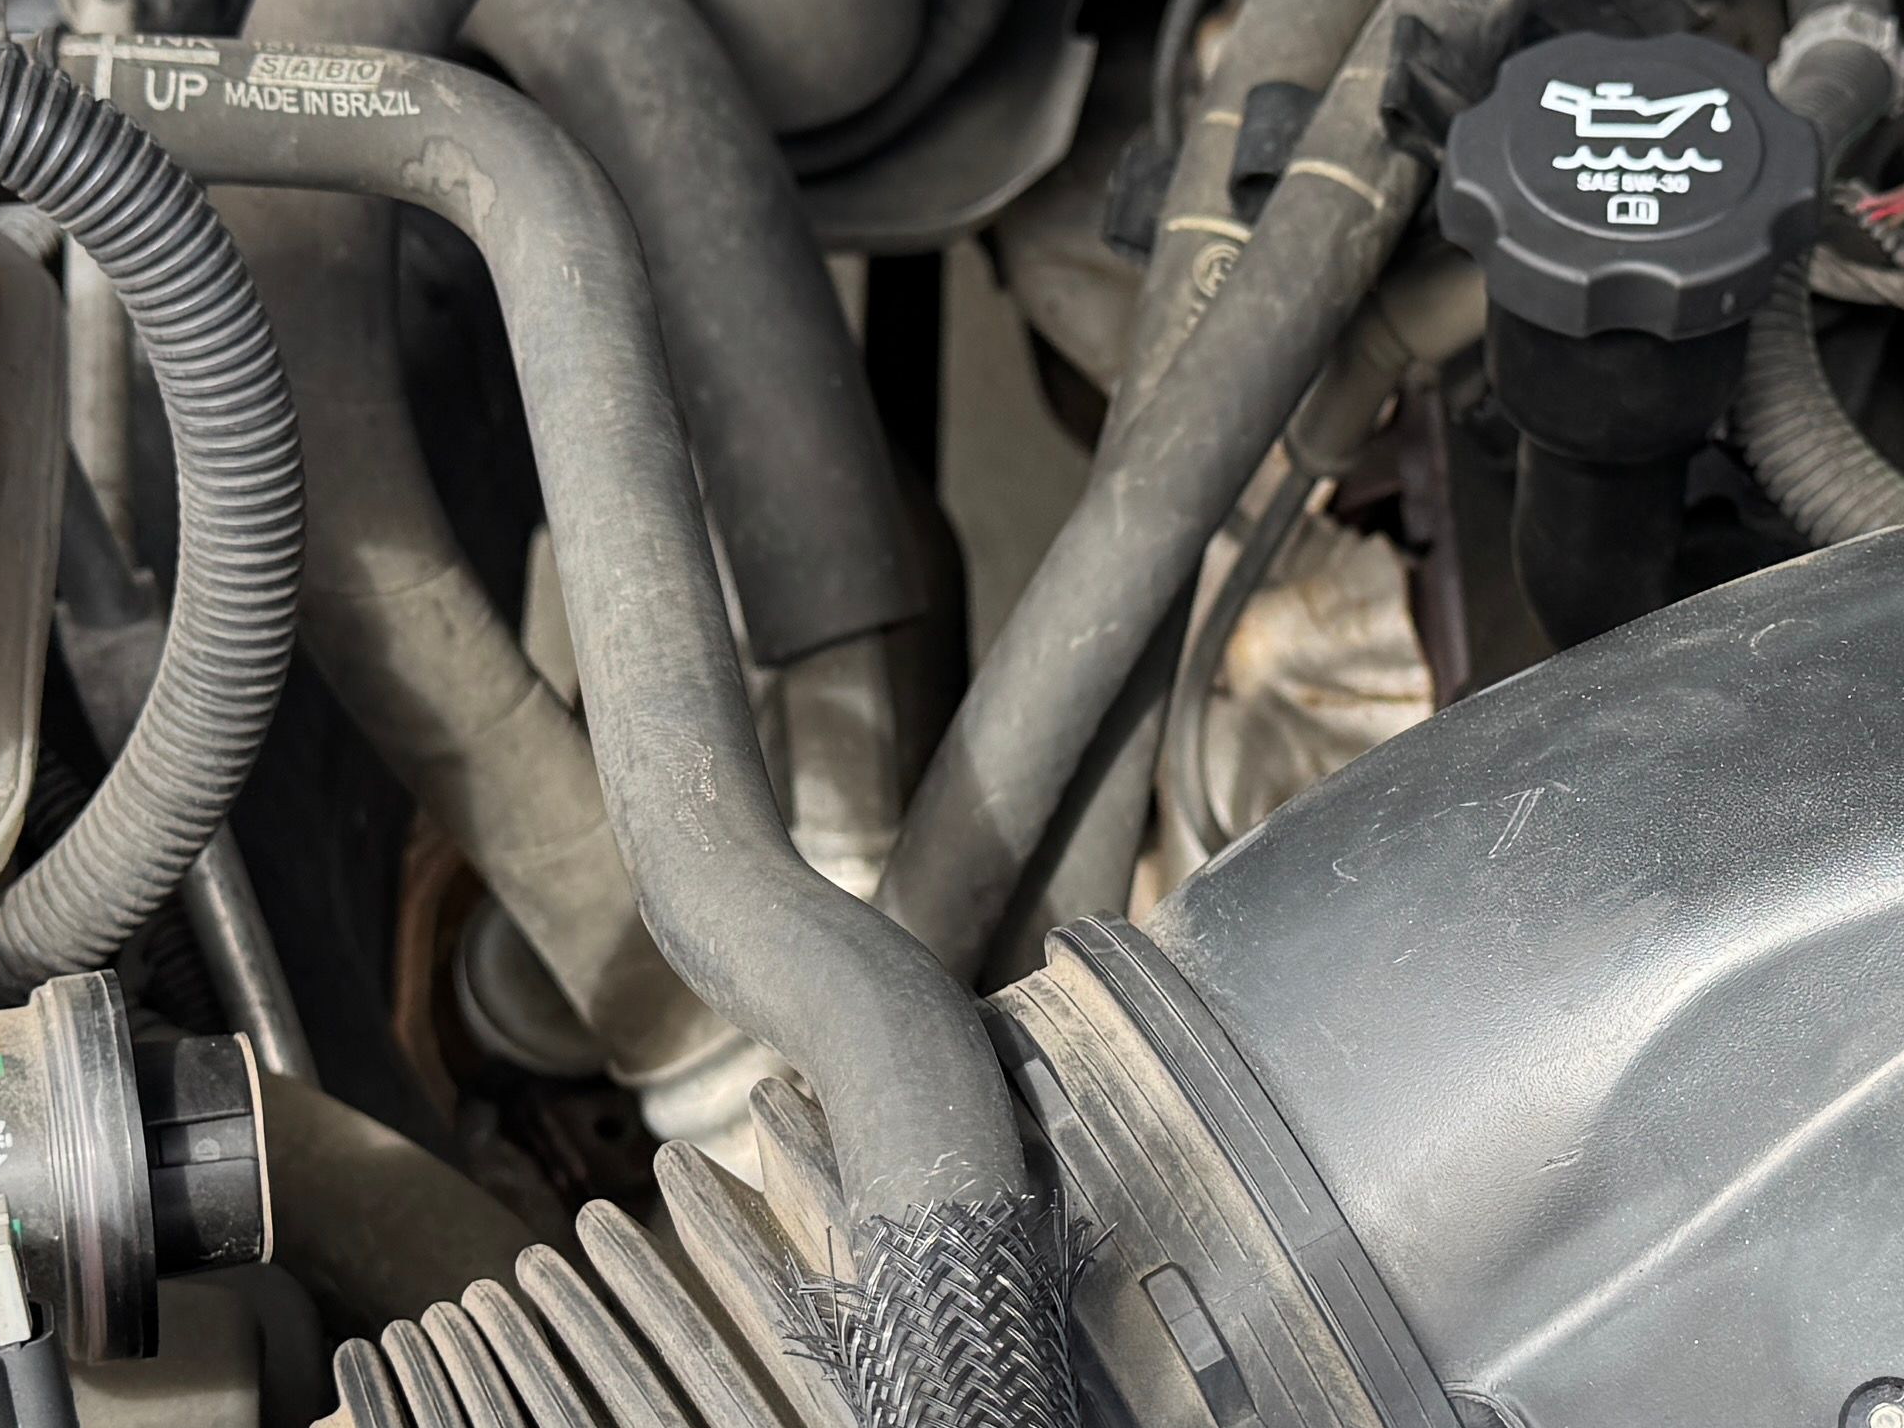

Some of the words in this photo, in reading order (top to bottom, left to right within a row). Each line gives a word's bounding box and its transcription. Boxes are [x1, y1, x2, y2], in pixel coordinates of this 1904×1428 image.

[145, 68, 208, 112] UP
[225, 82, 299, 113] MADE
[305, 91, 329, 115] IN
[329, 90, 420, 118] BRAZIL
[1577, 172, 1620, 192] SAE
